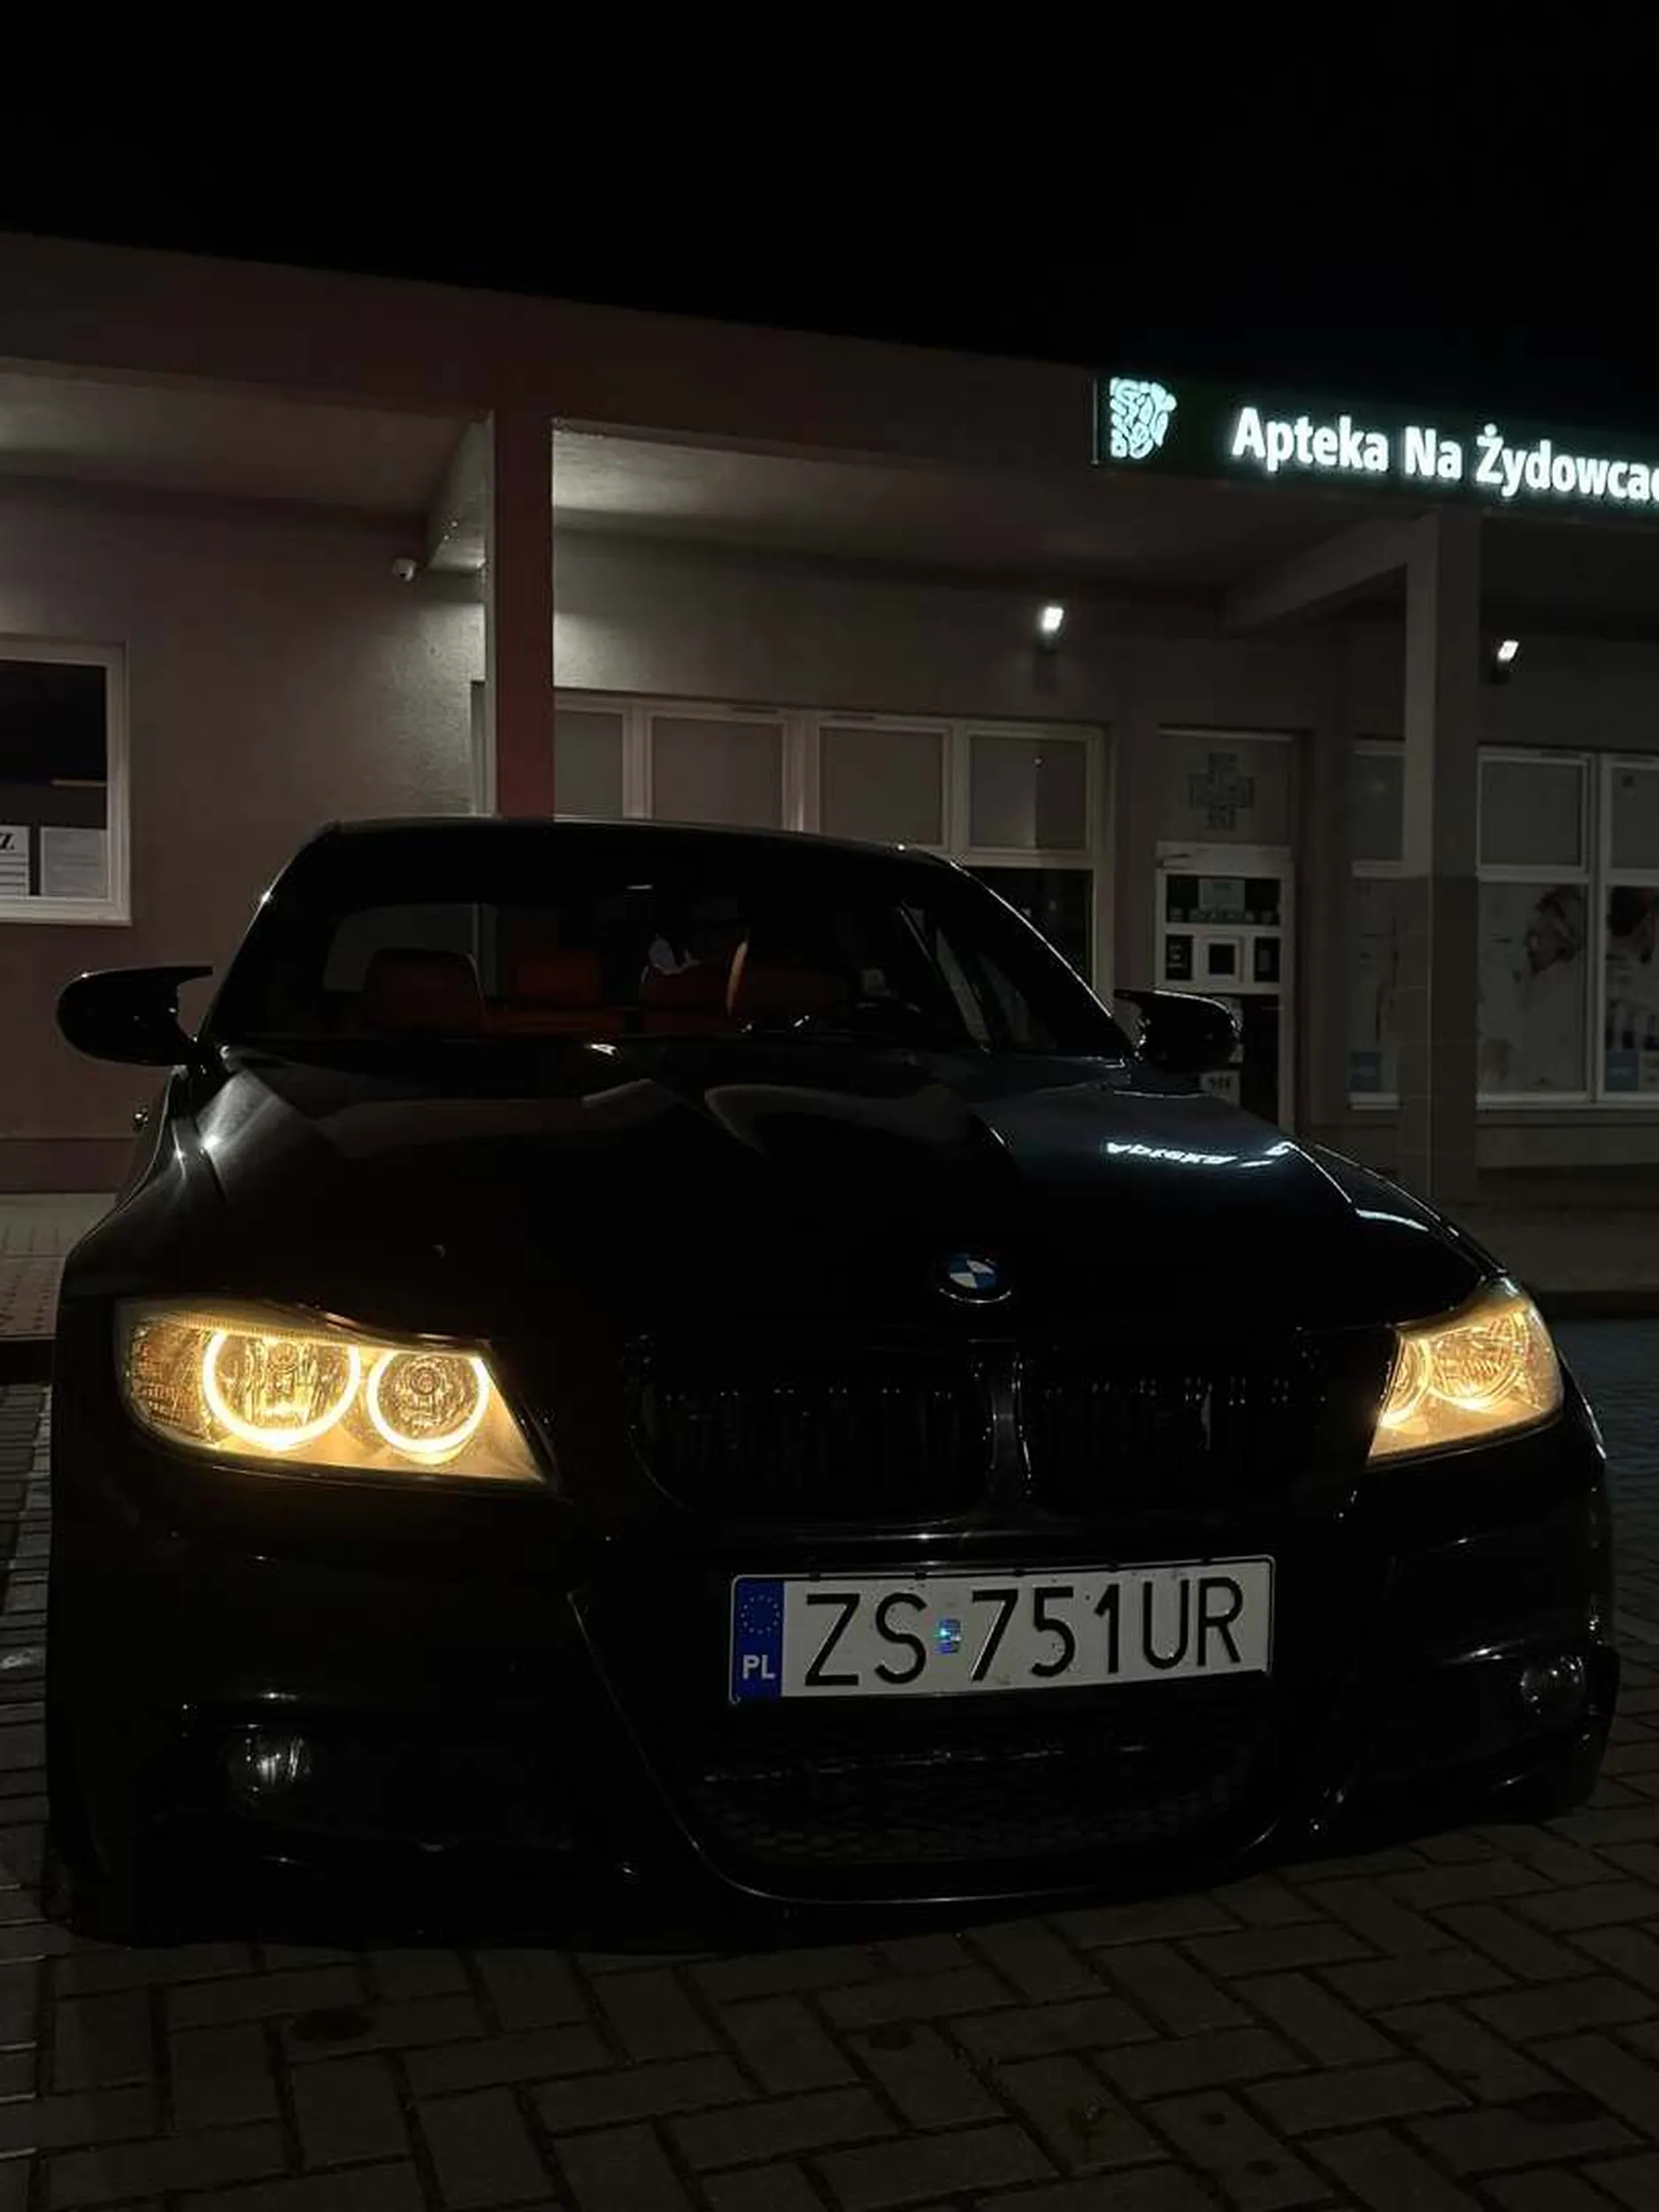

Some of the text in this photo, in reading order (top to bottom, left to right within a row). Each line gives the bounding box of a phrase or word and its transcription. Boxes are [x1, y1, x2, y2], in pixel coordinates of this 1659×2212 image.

[1232, 406, 1389, 472] Apteka
[1405, 426, 1463, 480] Na
[741, 1653, 777, 1681] PL
[805, 1578, 1242, 1686] ZS 751UR
